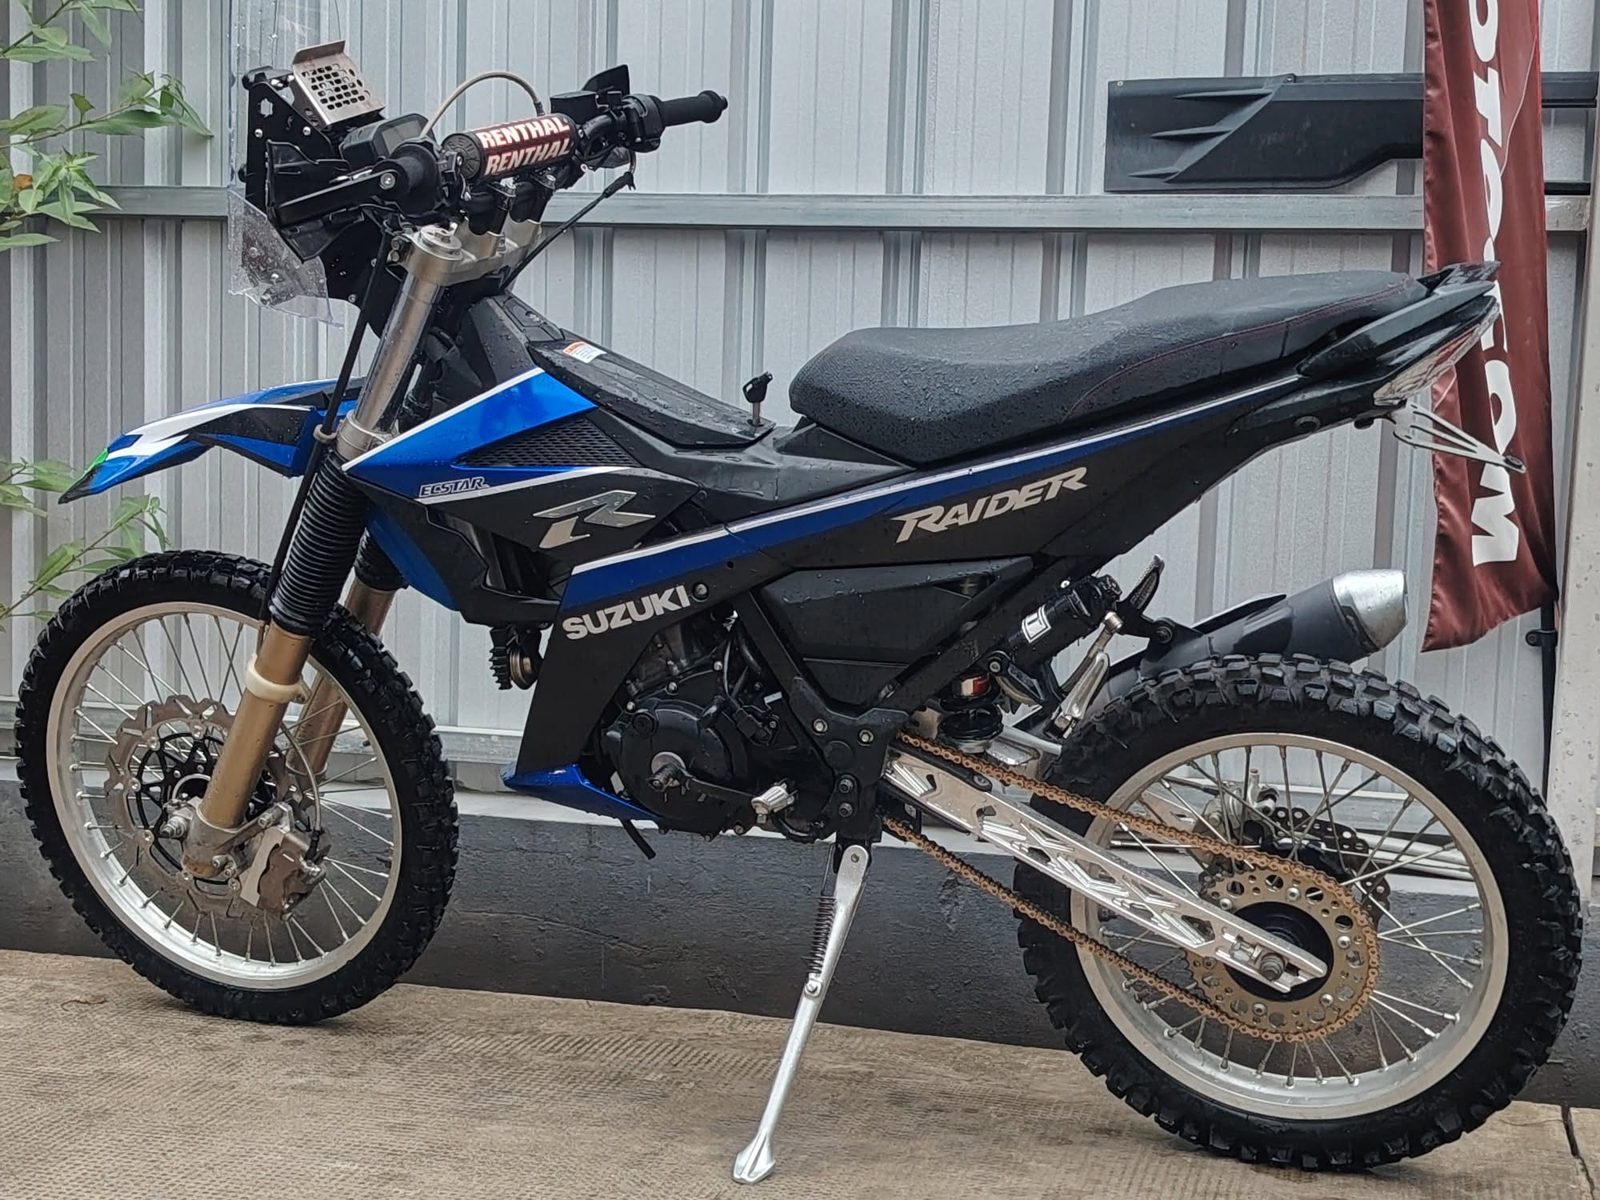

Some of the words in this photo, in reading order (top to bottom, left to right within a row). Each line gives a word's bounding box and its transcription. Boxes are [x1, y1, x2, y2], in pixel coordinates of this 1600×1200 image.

[476, 116, 570, 149] RENTHAL
[484, 138, 571, 176] RENTHAL
[419, 476, 486, 497] ECSTAR
[890, 466, 1088, 543] RAIDER
[562, 585, 691, 640] SUZUKI
